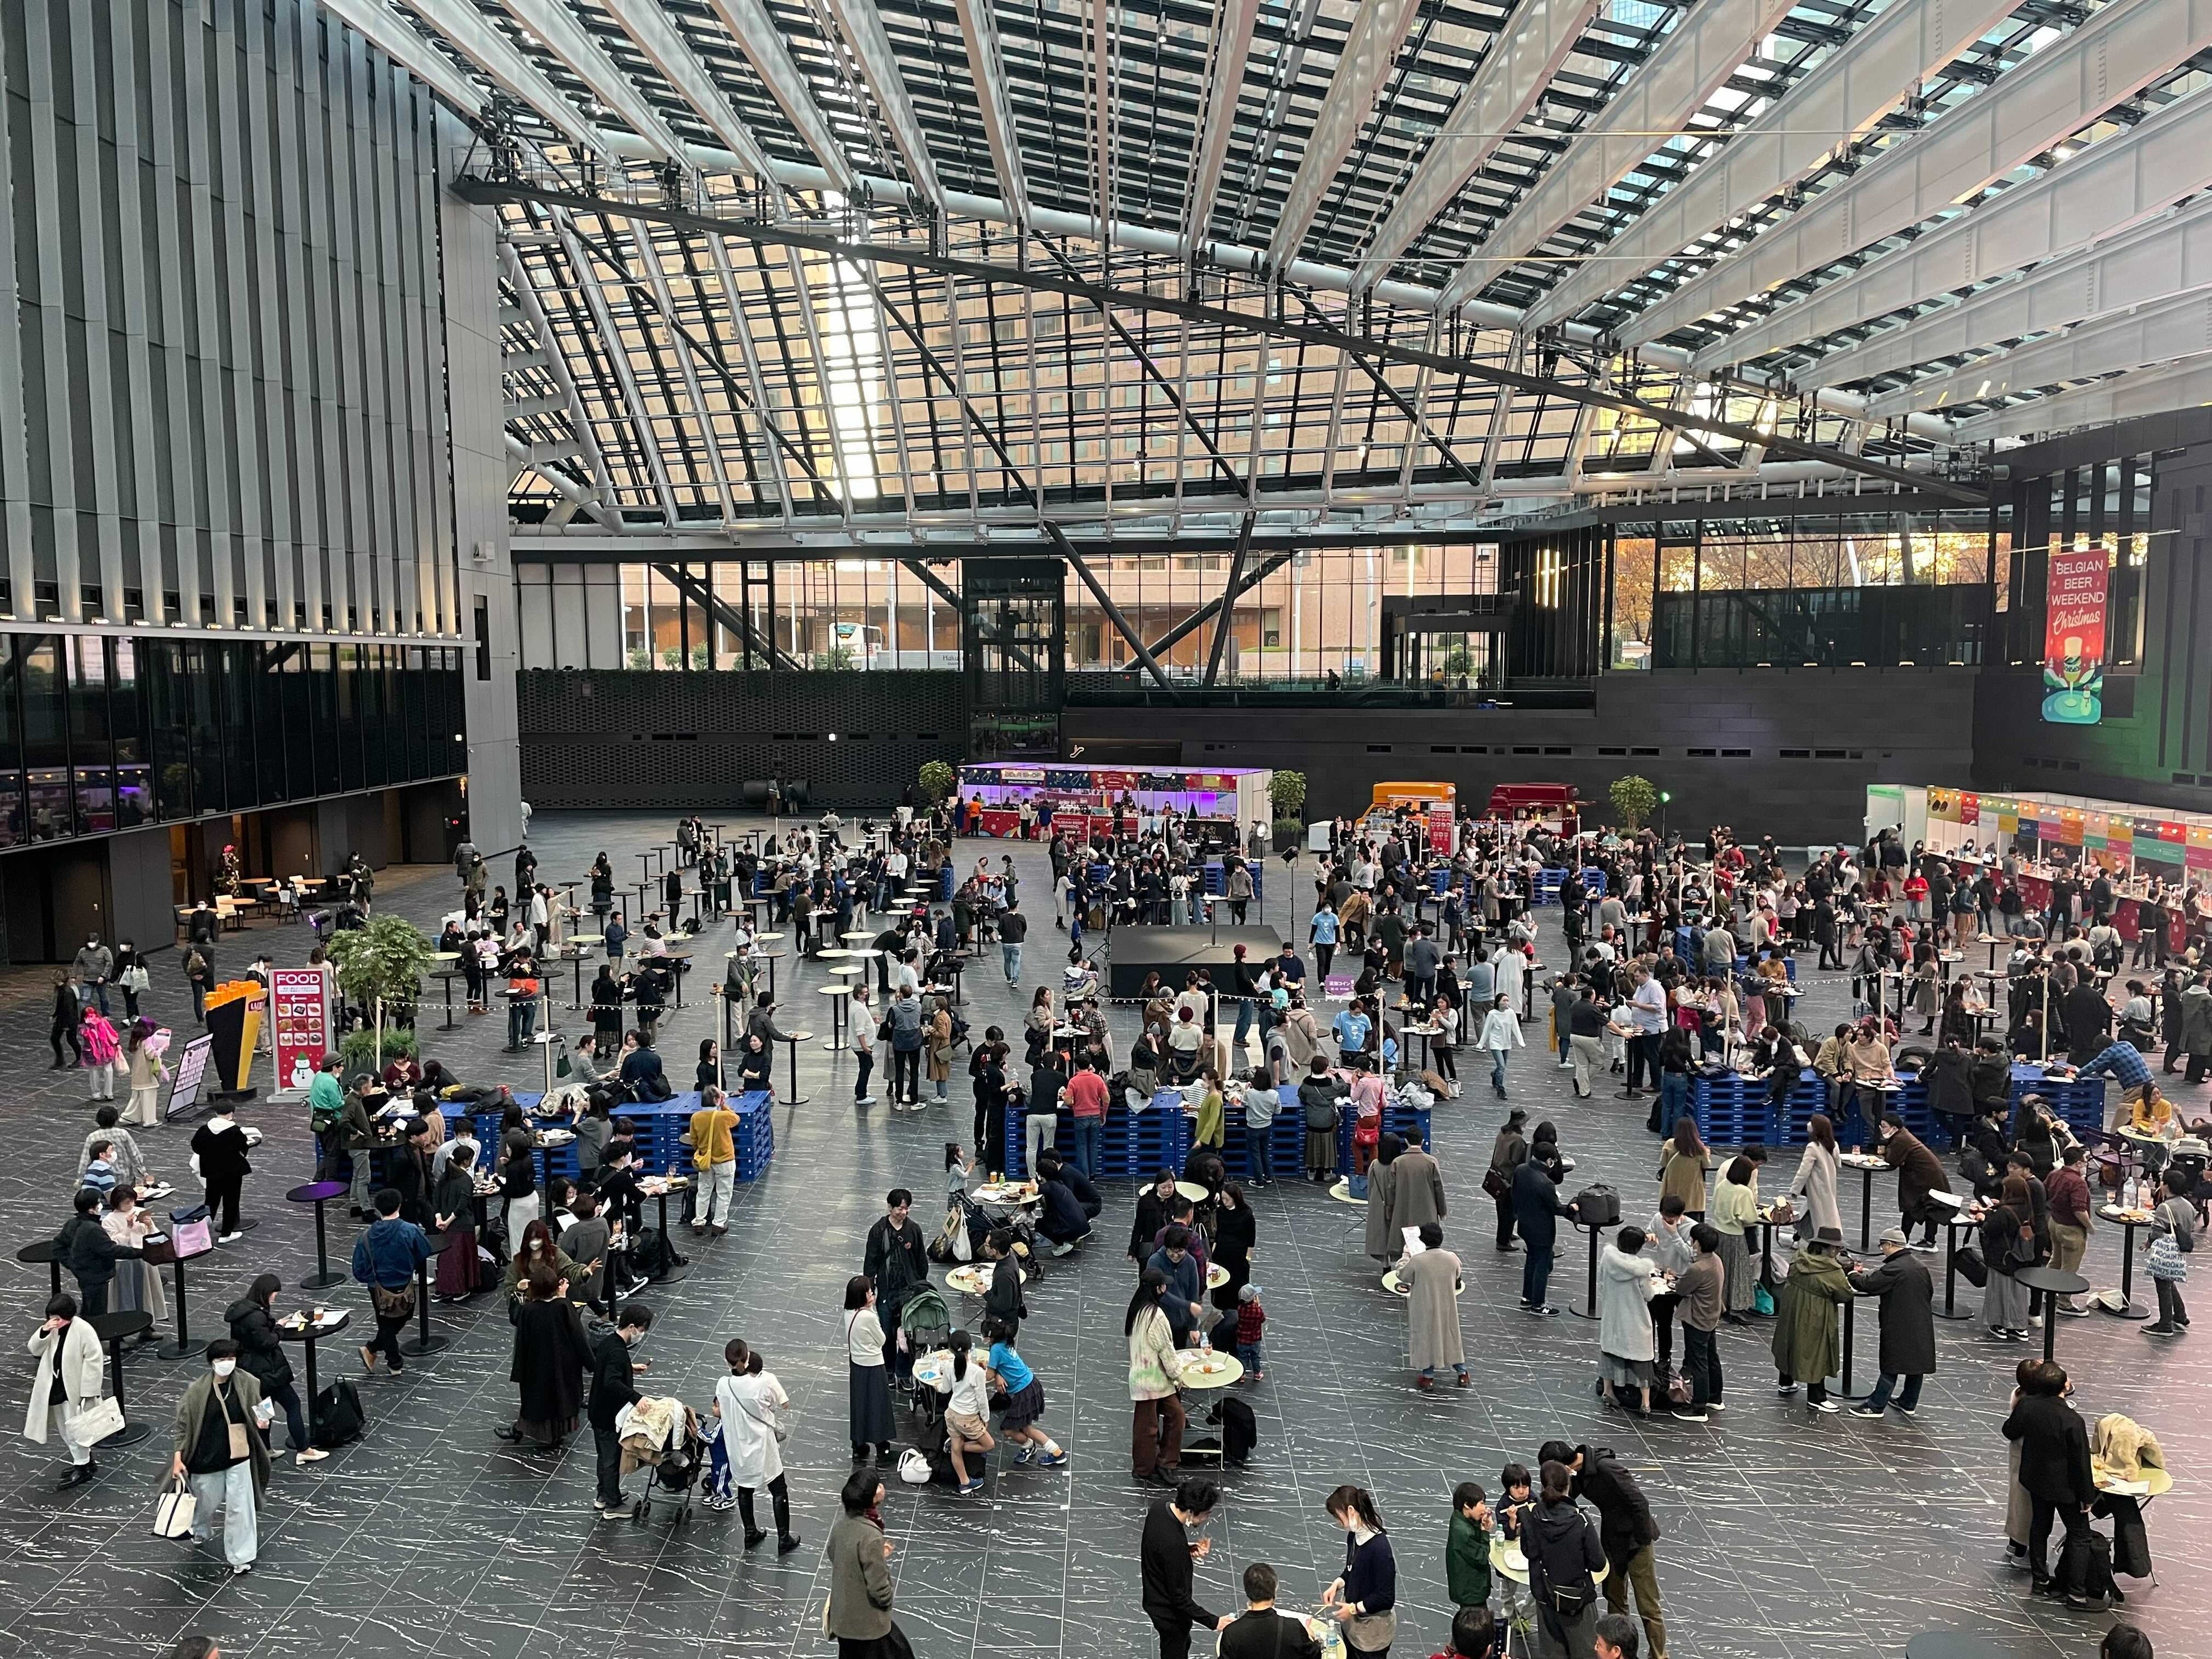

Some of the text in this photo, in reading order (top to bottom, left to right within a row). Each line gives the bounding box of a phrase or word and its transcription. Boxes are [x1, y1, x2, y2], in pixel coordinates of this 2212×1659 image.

[2056, 560, 2103, 575] BELGIAN
[2064, 576, 2092, 590] BEER
[2051, 592, 2105, 606] WEEKEND
[2053, 607, 2100, 635] Christmas
[276, 974, 320, 985] FOOD
